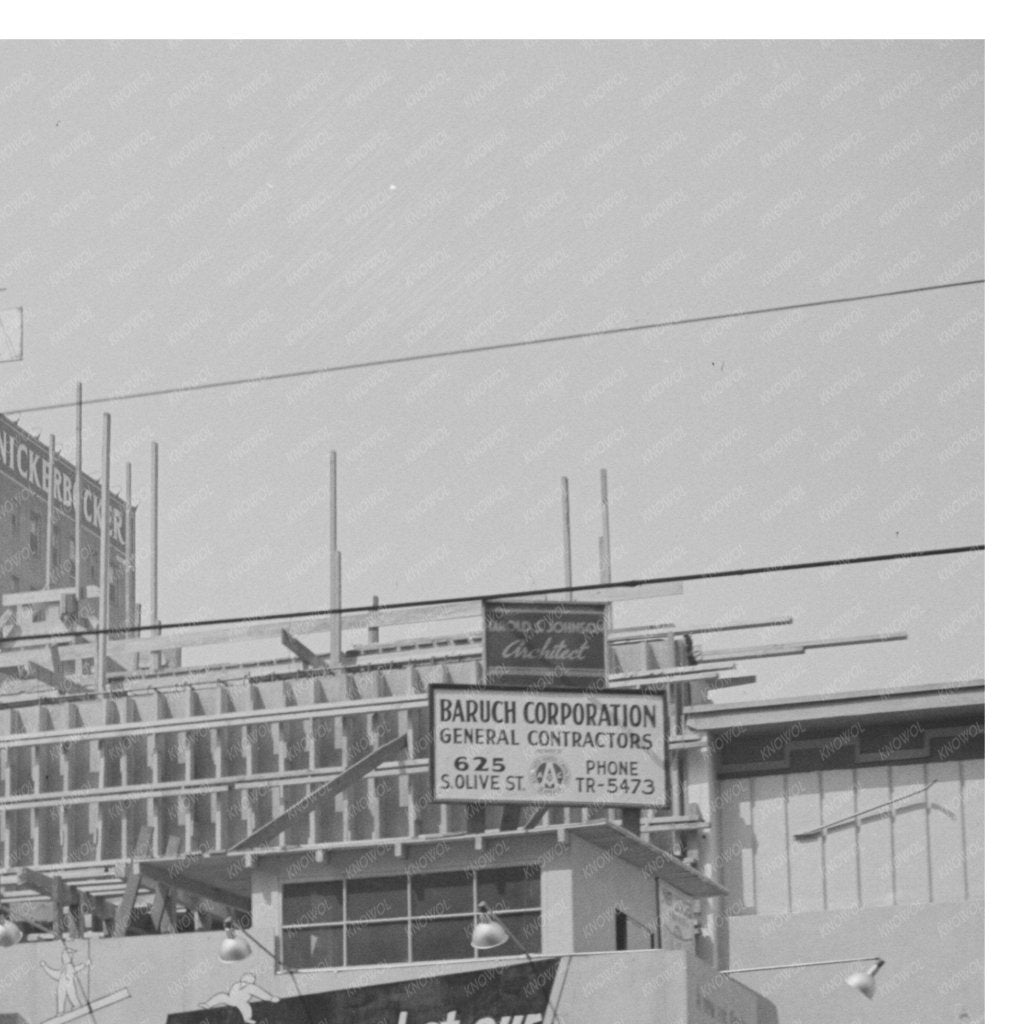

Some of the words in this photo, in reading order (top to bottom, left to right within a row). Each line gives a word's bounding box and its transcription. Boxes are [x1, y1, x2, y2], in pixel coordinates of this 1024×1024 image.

[502, 637, 590, 660] Architect
[440, 699, 516, 724] BARUCH
[523, 701, 656, 729] CORPORATION
[439, 728, 520, 746] GENERAL
[527, 730, 653, 750] CONTRACTORS
[454, 756, 506, 773] 625
[586, 760, 638, 776] PHONE
[576, 777, 655, 795] TR-5473
